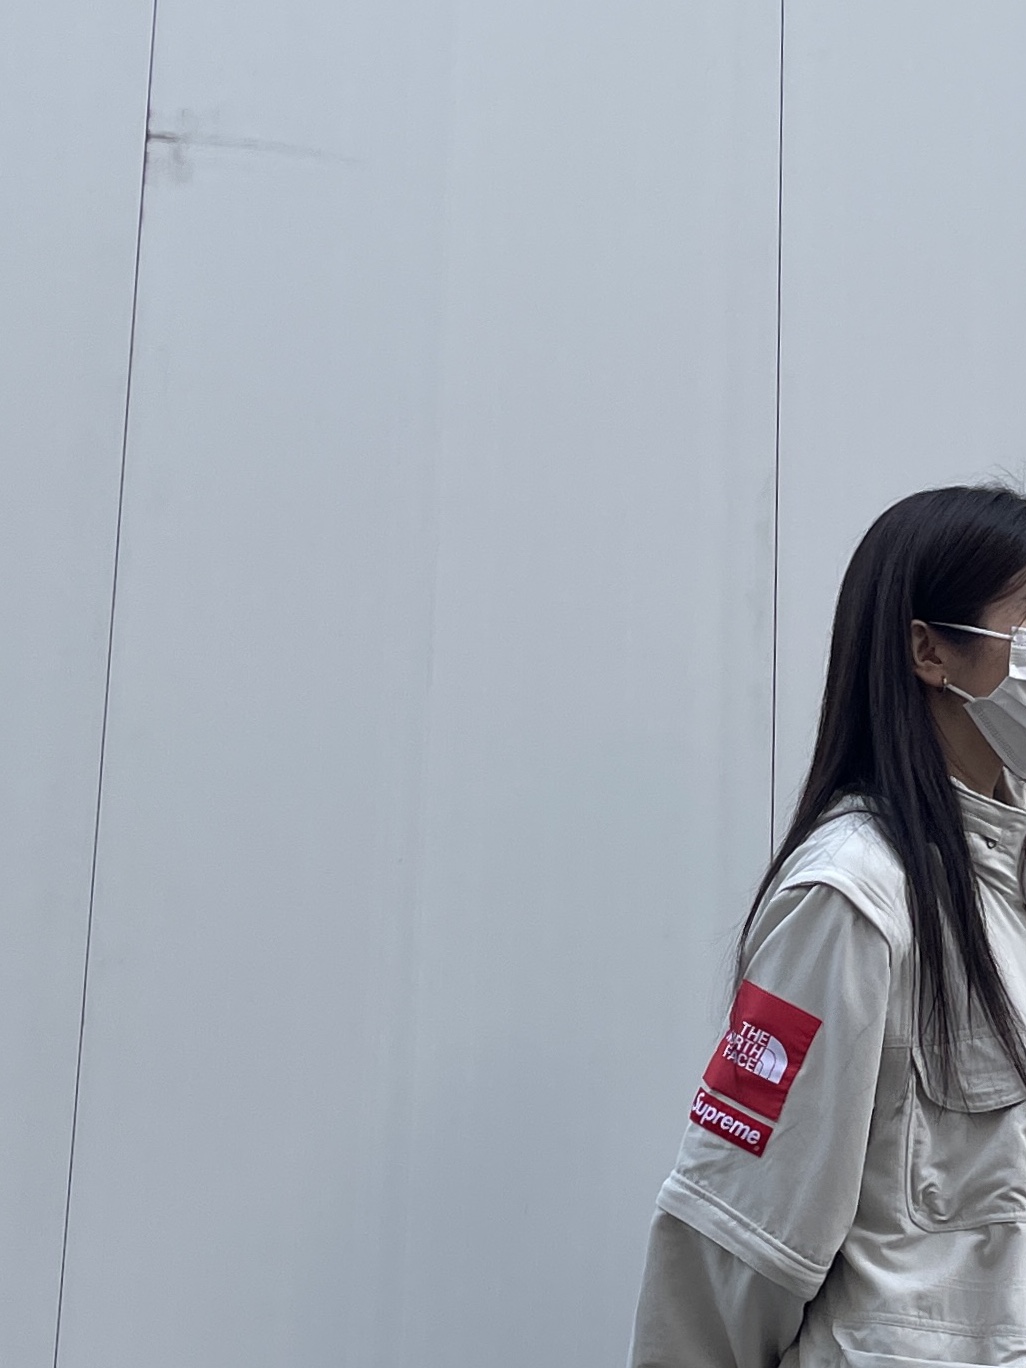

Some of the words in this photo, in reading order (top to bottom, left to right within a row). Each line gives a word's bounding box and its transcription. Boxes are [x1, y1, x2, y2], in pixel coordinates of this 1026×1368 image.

[741, 1021, 770, 1046] THE
[722, 1044, 757, 1072] FACE
[692, 1092, 761, 1145] Supreme
